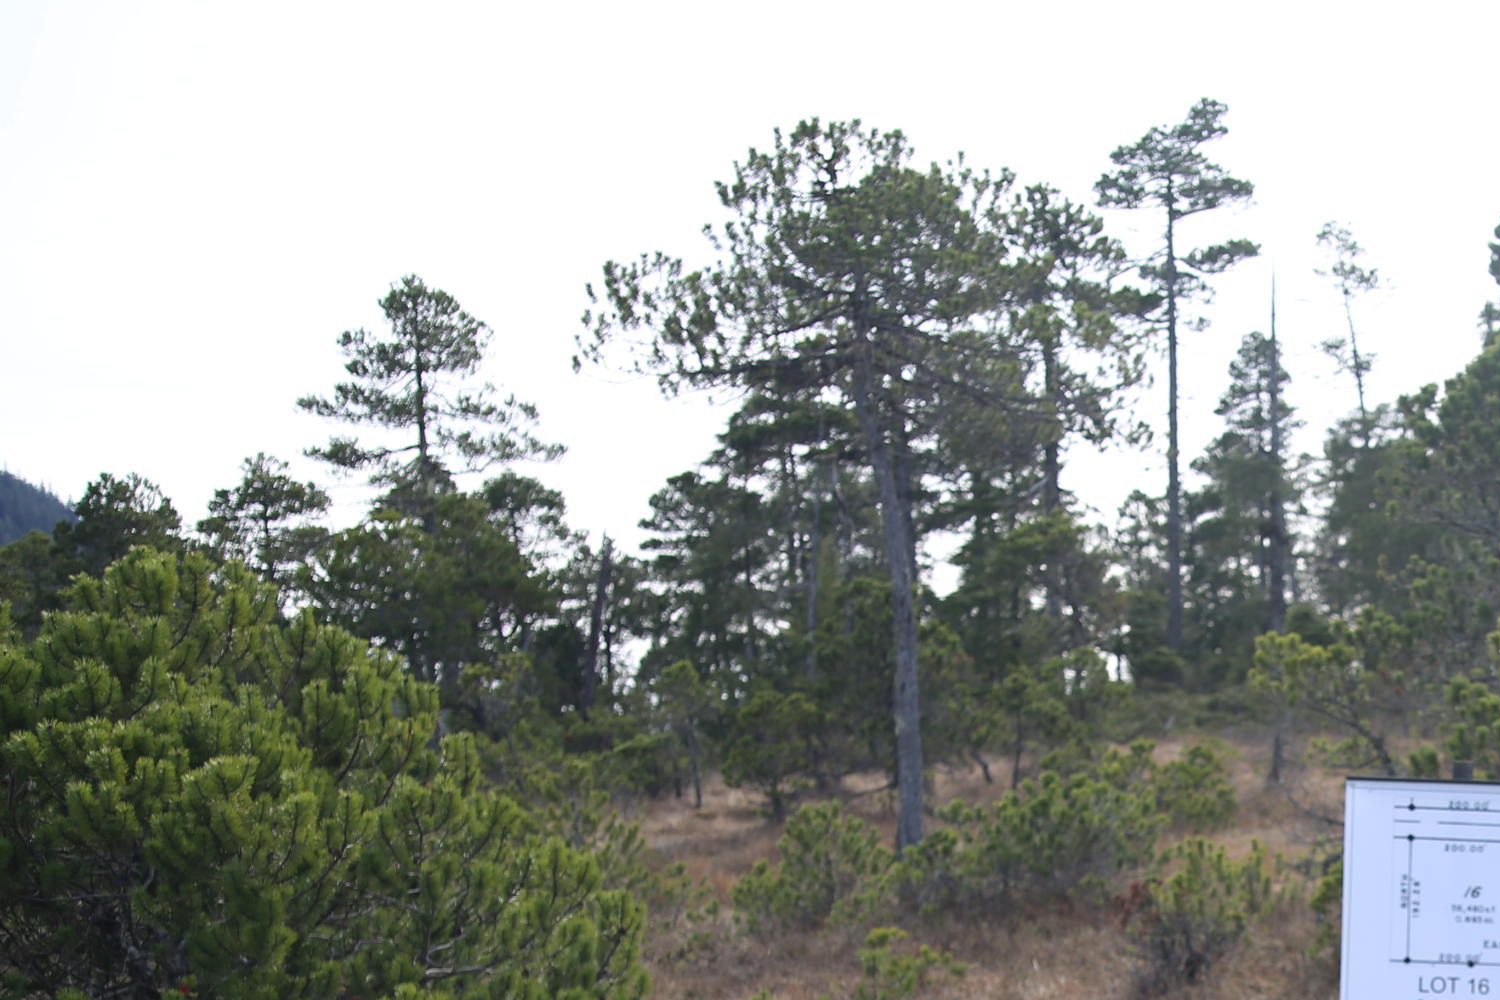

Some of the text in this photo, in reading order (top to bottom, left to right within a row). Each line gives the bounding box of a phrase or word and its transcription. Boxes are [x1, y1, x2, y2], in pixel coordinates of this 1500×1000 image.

[1463, 885, 1483, 899] 16
[1418, 976, 1490, 995] LOT 16
